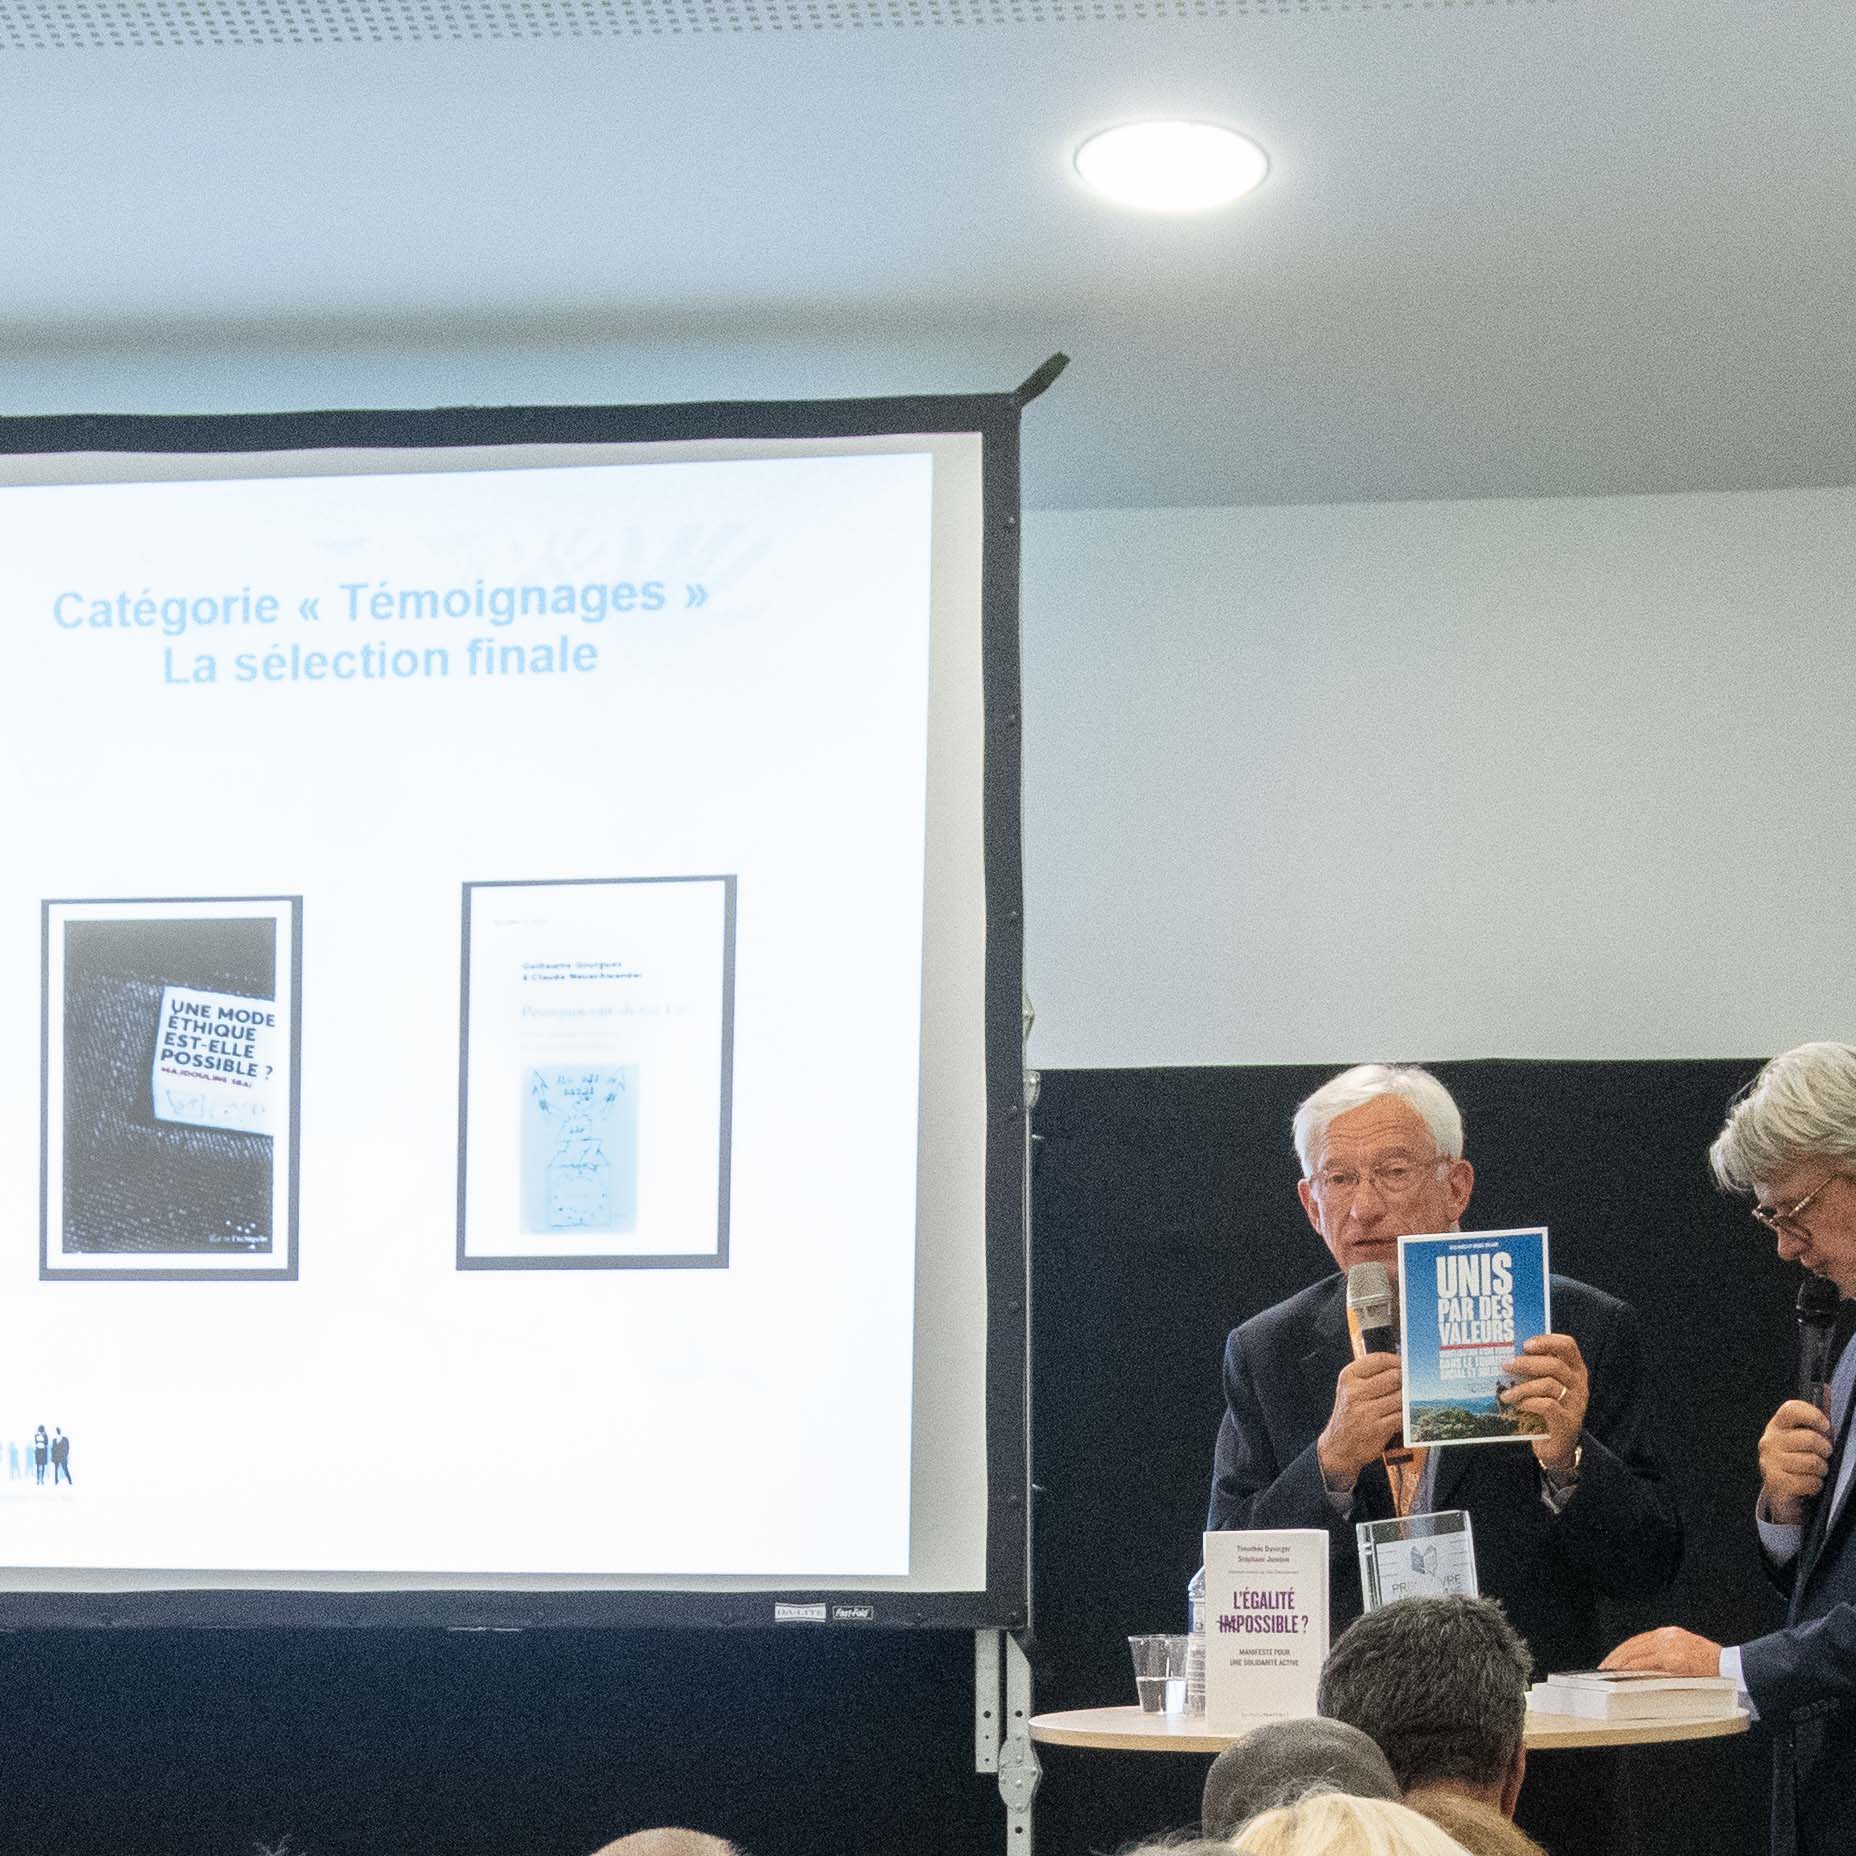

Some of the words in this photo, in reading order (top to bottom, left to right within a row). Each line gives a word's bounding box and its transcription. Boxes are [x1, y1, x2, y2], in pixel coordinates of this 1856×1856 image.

[52, 586, 280, 637] Catégorie
[339, 578, 666, 628] Témoignages
[163, 646, 218, 686] La
[235, 640, 449, 682] sélection
[467, 634, 599, 677] finale
[171, 1000, 211, 1019] UNE
[218, 1007, 276, 1028] MODE
[164, 1032, 255, 1059] EST-ELLE
[161, 1048, 258, 1077] POSSIBLE
[264, 1065, 273, 1080] ?
[1435, 1251, 1513, 1299] UNIS
[1438, 1297, 1475, 1323] PAR
[1478, 1293, 1514, 1321] DES
[1439, 1318, 1515, 1346] VALEURS
[1233, 1586, 1295, 1610] L'ÉGALITÉ
[1217, 1615, 1299, 1635] IMPOSSIBLE
